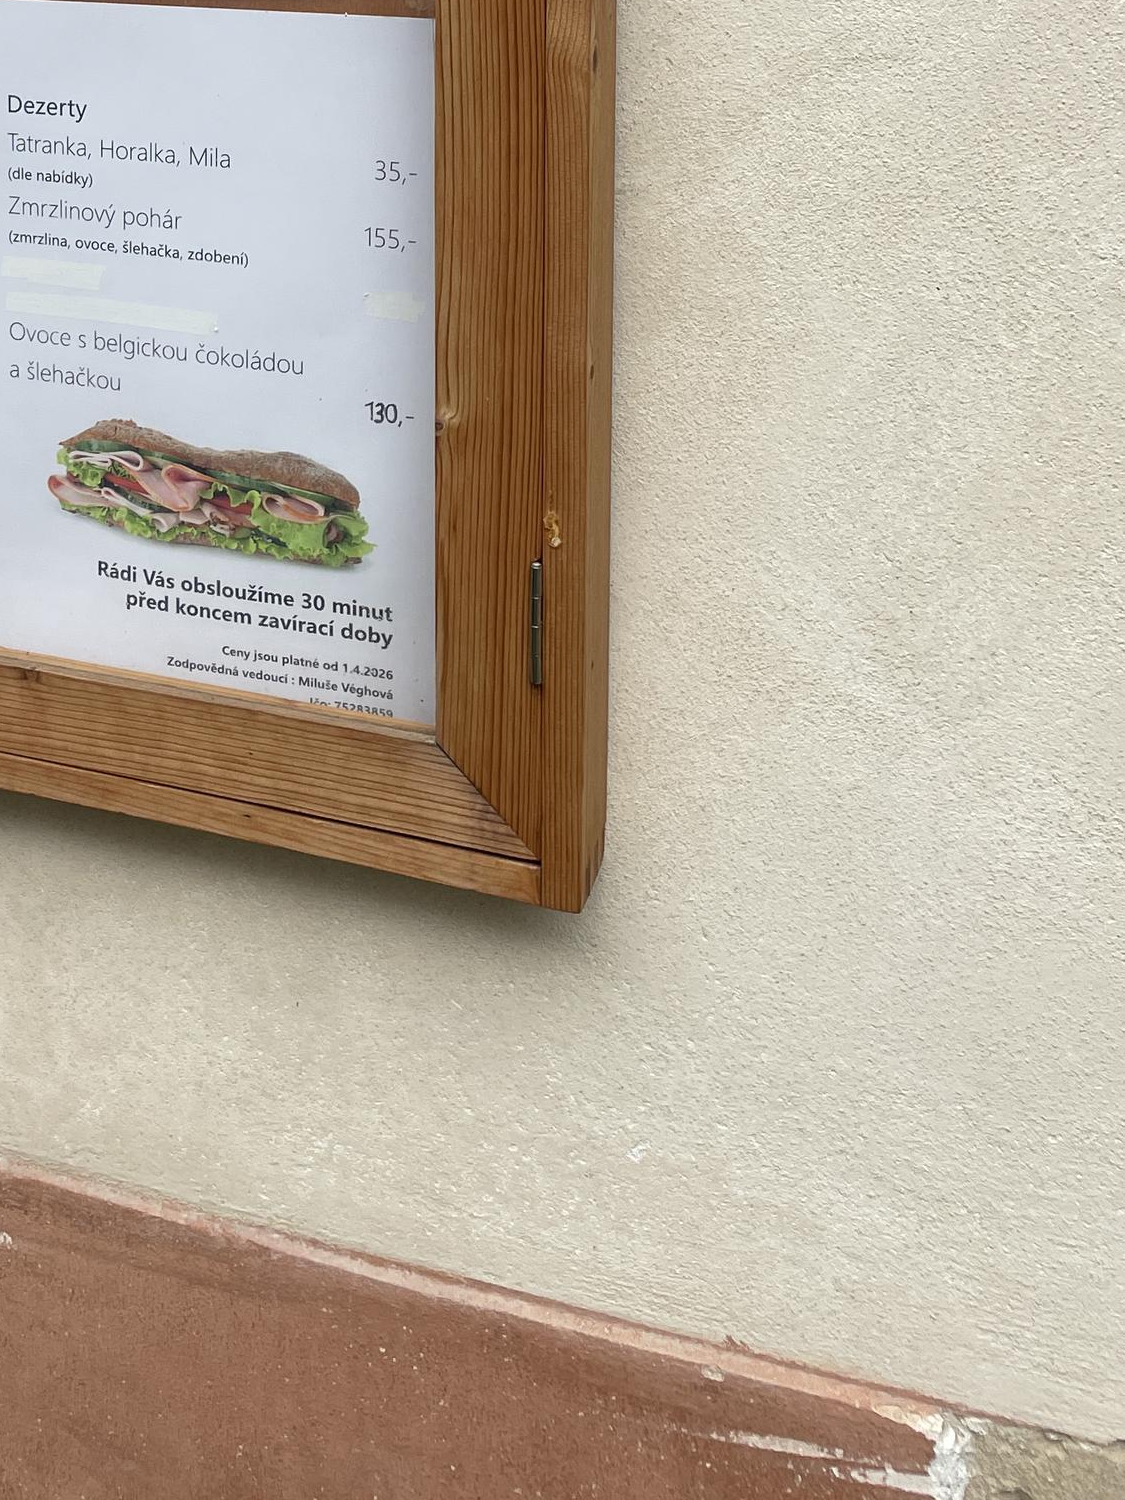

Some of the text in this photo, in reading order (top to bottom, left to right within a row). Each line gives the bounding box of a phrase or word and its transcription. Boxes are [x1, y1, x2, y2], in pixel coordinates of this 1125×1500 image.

[8, 95, 87, 123] Dezerty
[8, 132, 231, 168] Tatranka, Horalka, Mila
[36, 168, 93, 188] nabídky)
[8, 196, 417, 252] Zmrzlinový pohár 155,-
[9, 230, 249, 268] (zmrzlina, ovoce, šlehačka, zdobení)
[9, 322, 304, 376] Ovoce belgickou čokoládou
[27, 360, 414, 427] šlehačkou 130,-
[97, 561, 325, 612] Rádi Vás obsloužíme 30
[126, 591, 393, 649] před koncem zavírací doby
[167, 656, 239, 678] Zodpovědná
[242, 669, 289, 684] vedoucí
[298, 677, 338, 692] Miluše
[282, 652, 393, 681] platné 1.4.2026
